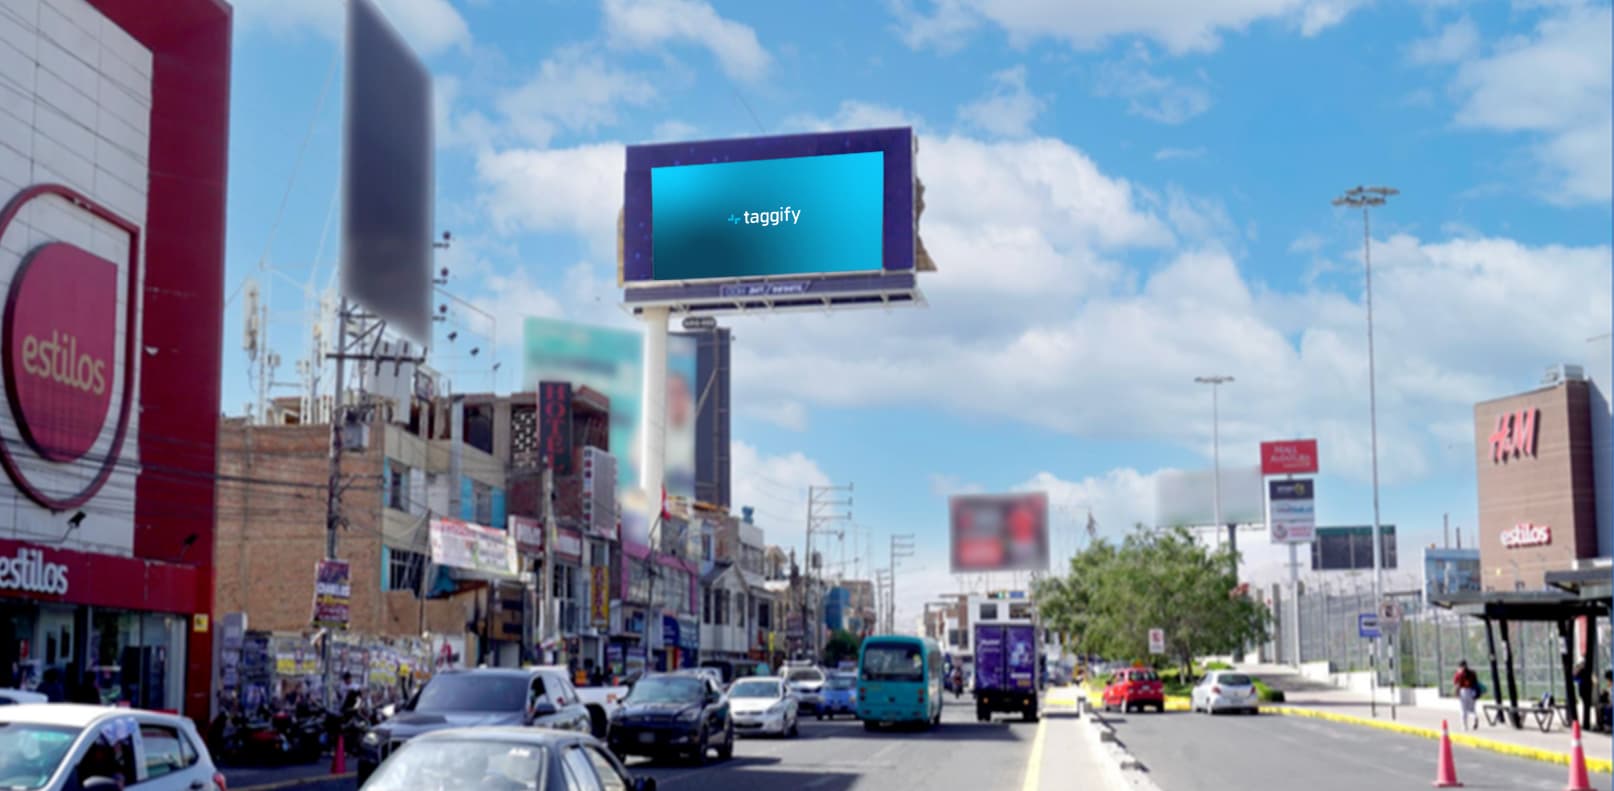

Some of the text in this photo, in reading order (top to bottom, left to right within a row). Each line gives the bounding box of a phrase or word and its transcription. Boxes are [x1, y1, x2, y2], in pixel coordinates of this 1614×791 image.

[744, 206, 801, 226] taggify
[22, 330, 106, 395] estilos
[545, 384, 566, 471] HOTEL
[1488, 407, 1536, 461] H&M
[1500, 523, 1550, 546] estilos
[0, 547, 69, 595] estilos
